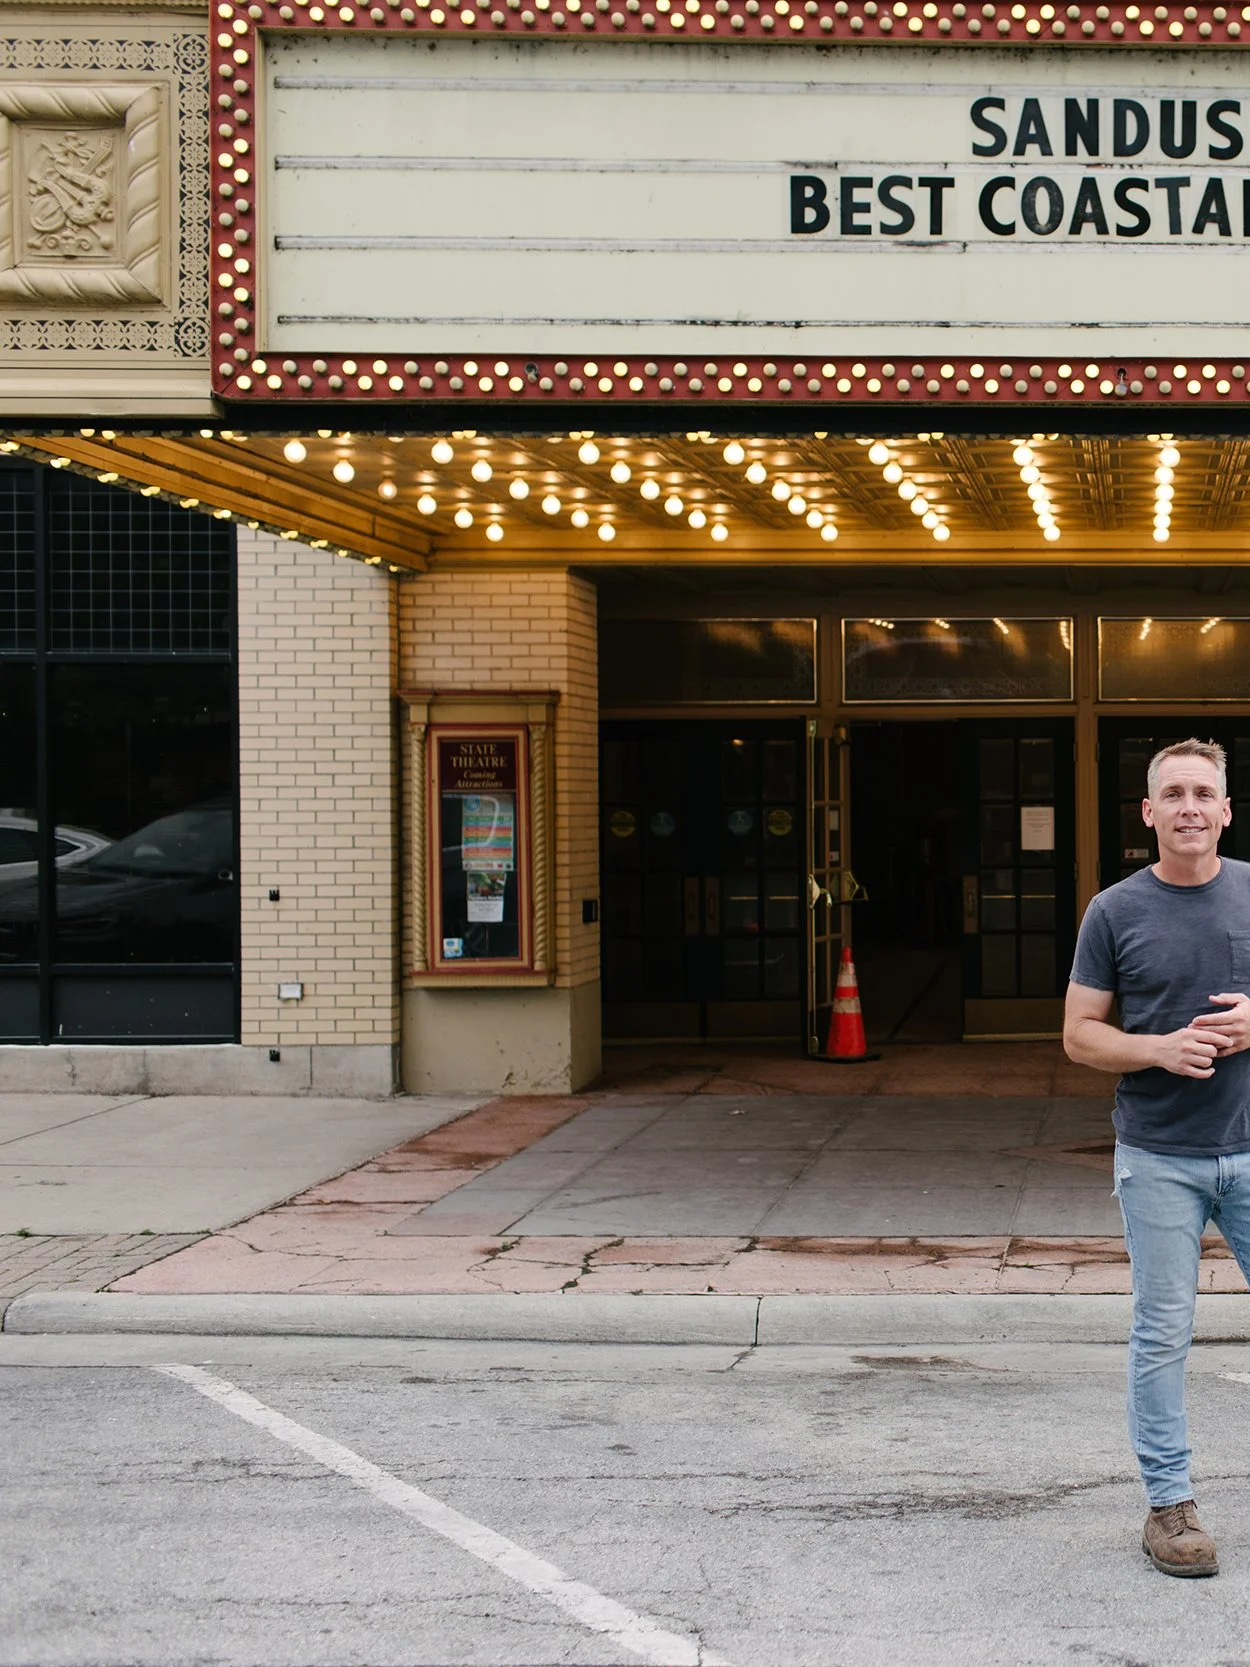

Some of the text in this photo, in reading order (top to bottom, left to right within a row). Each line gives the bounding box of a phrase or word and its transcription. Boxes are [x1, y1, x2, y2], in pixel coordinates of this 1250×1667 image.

[790, 175, 955, 236] BEST
[460, 743, 497, 755] STATE
[450, 756, 508, 768] THEATRE
[463, 769, 496, 780] Coming
[454, 779, 503, 789] Attractions
